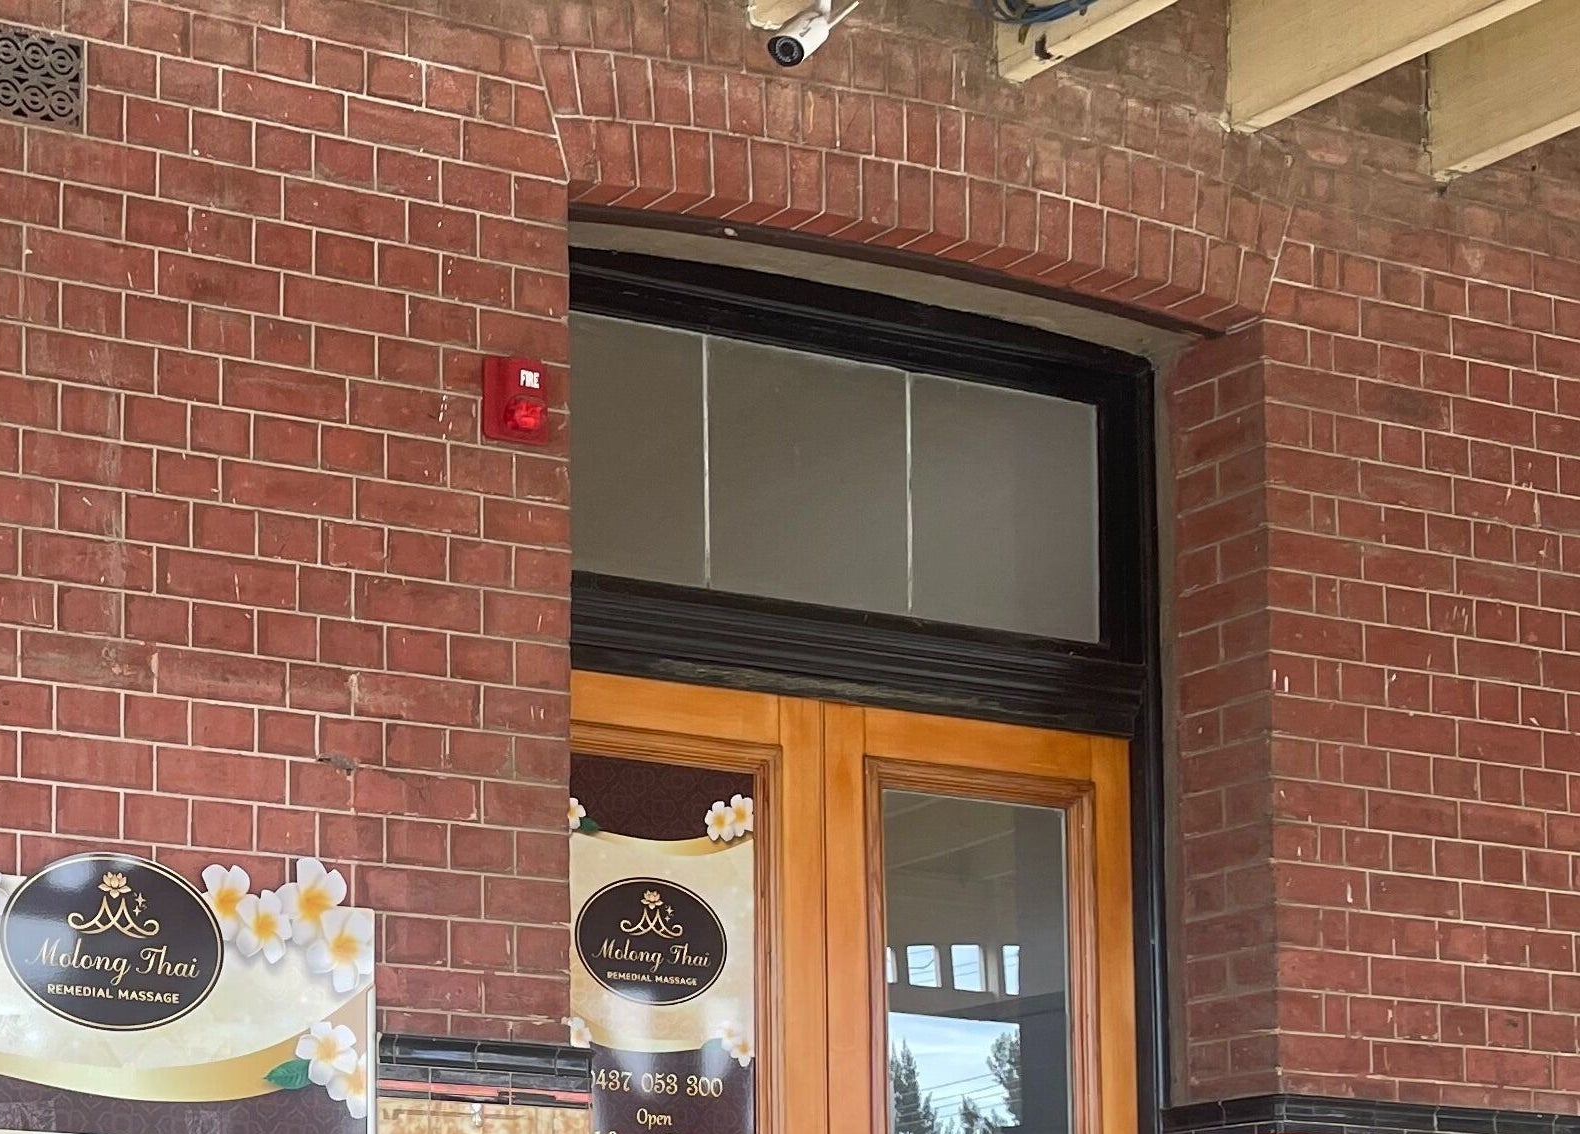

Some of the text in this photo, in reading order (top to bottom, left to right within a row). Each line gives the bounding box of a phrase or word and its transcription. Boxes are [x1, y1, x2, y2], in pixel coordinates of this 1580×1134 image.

[25, 937, 200, 986] Molong Thai
[591, 937, 711, 973] Molong Thai
[607, 971, 698, 986] REMEDIAL MASSAGE
[47, 983, 180, 1004] REMEDIAL MASSAGE
[641, 1072, 678, 1095] 053
[686, 1075, 723, 1098] 300
[636, 1108, 672, 1130] Open
